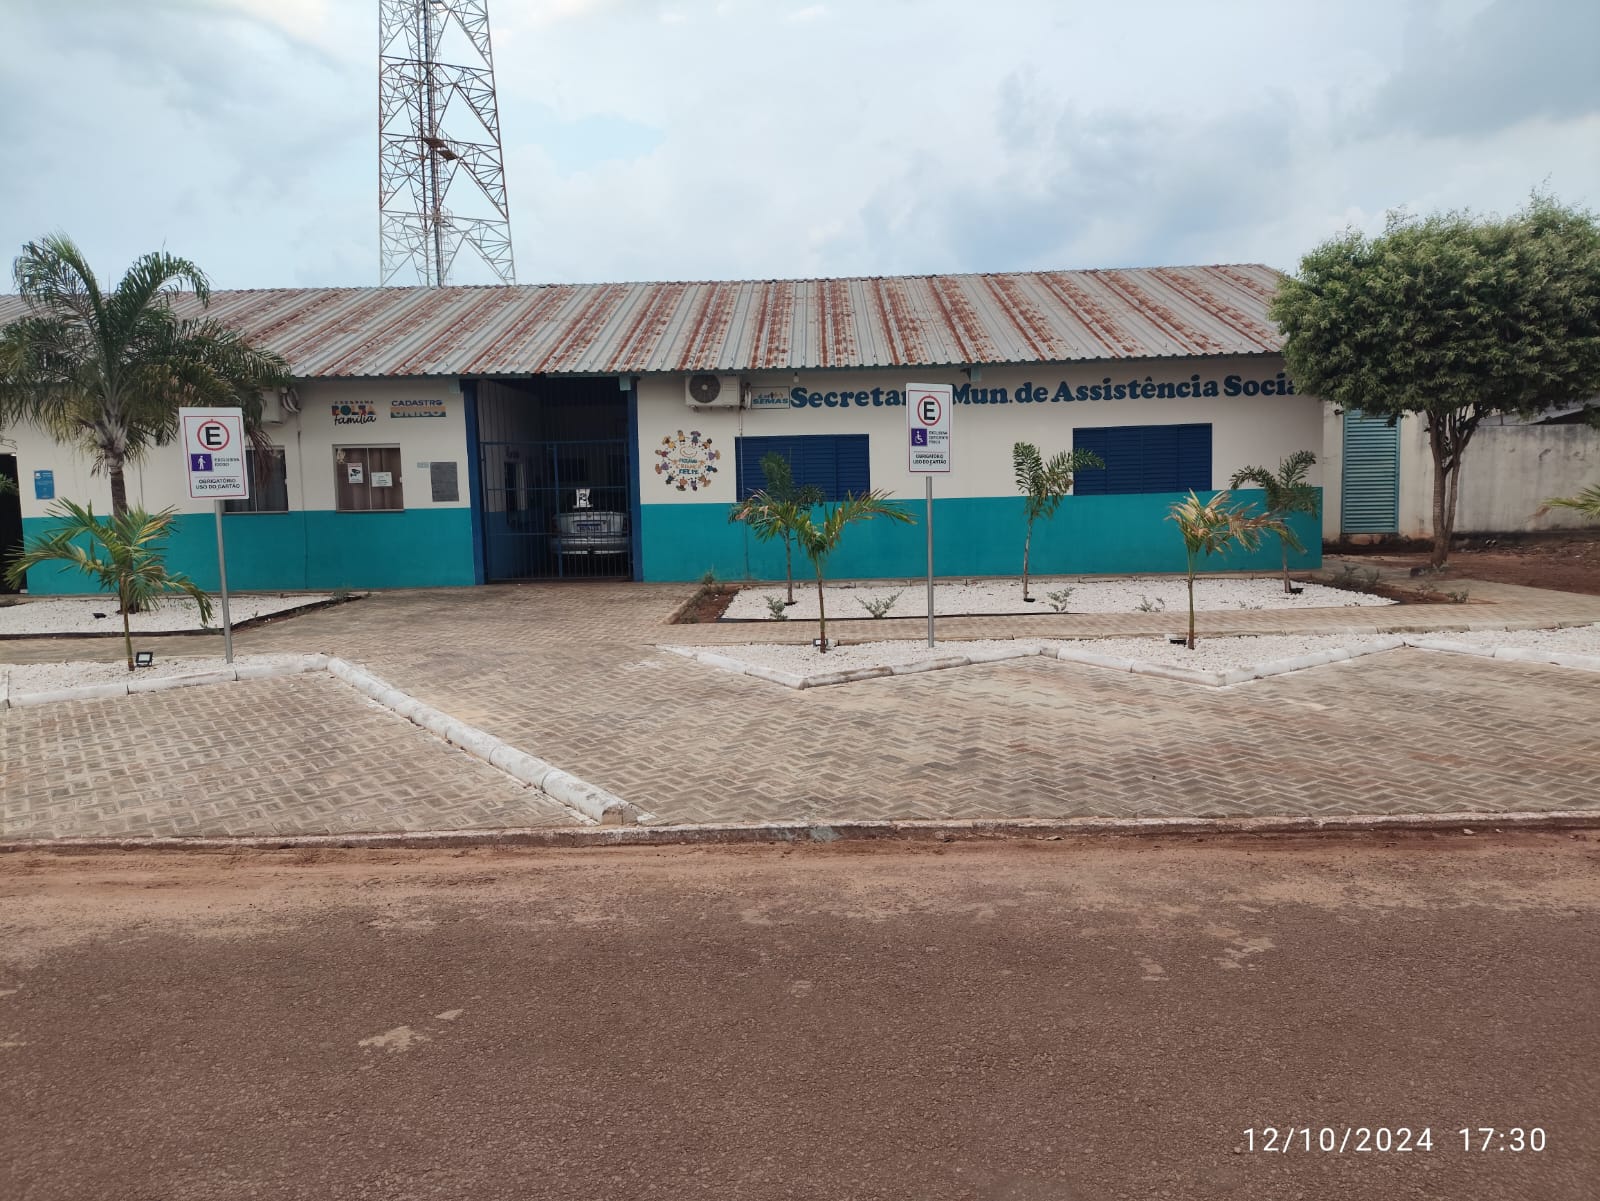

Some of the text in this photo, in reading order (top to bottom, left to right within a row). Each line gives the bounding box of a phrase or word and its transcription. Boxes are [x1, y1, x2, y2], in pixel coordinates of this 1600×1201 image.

[1014, 381, 1048, 404] de
[1050, 374, 1220, 403] Assistência
[391, 399, 443, 407] CADASTRO
[923, 401, 936, 420] E
[205, 426, 222, 445] E
